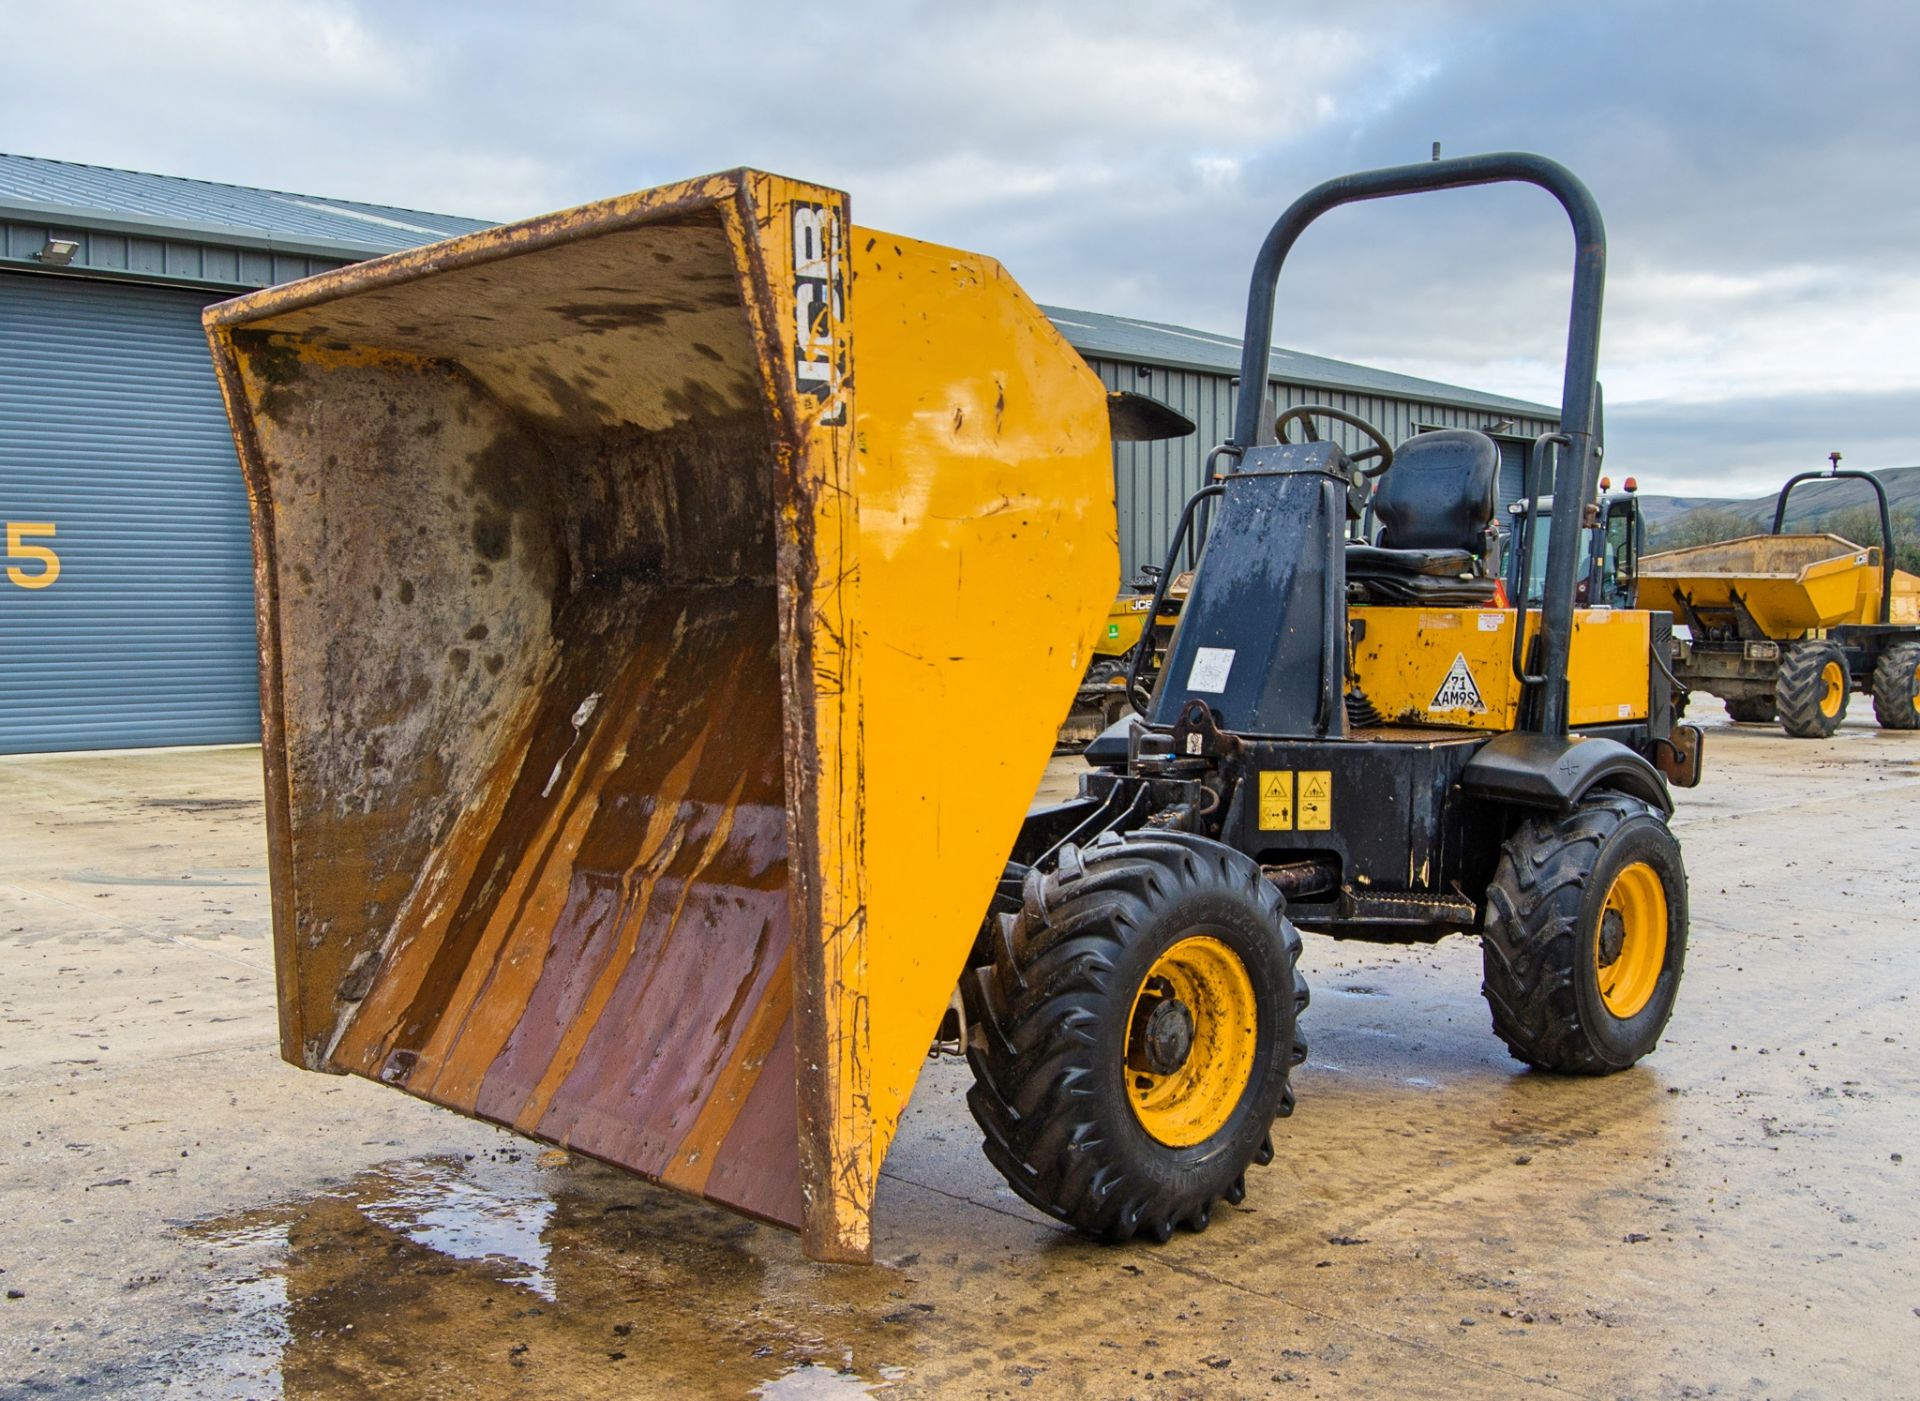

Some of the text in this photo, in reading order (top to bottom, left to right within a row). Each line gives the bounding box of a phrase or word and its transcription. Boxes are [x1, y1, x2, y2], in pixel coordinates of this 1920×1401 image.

[793, 207, 843, 419] JCB
[6, 521, 61, 589] 5
[1131, 600, 1153, 610] JCB
[1451, 676, 1466, 690] 71
[1442, 691, 1475, 705] AM9S
